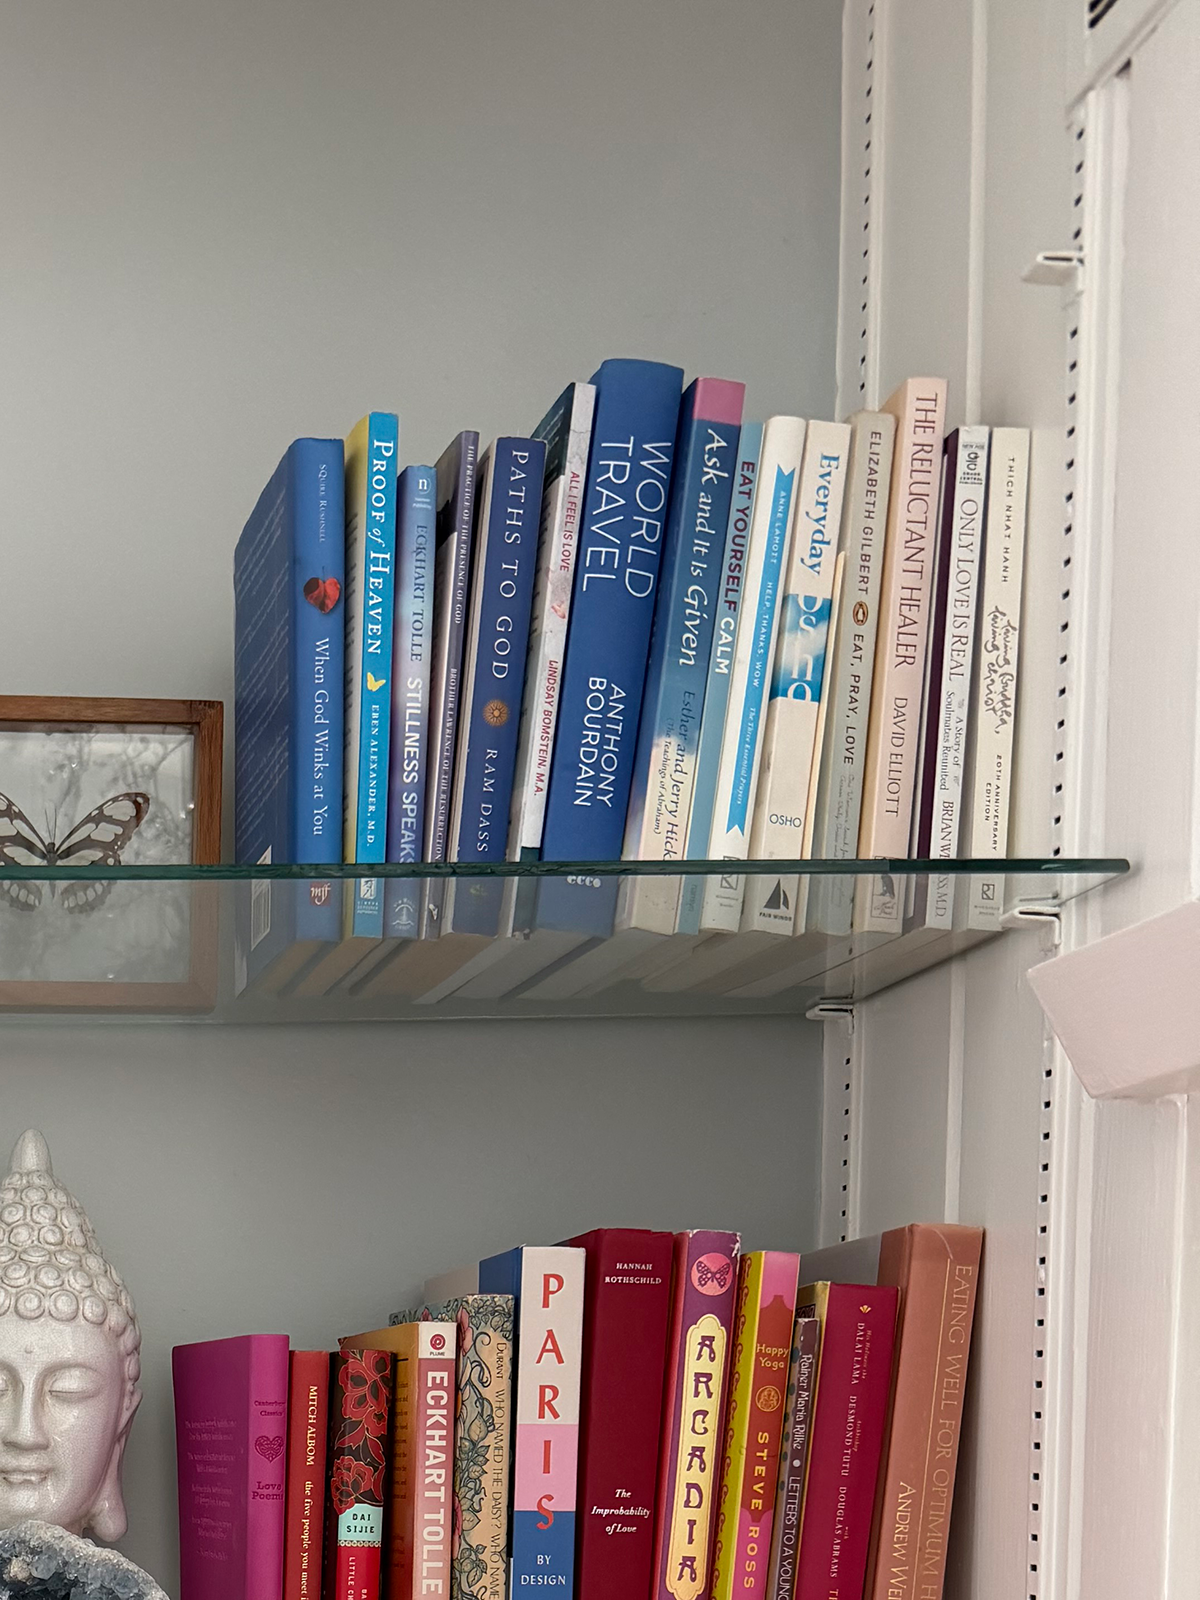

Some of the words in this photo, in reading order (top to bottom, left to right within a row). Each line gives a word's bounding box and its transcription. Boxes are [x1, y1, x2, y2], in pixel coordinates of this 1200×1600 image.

[914, 393, 938, 434] THE
[701, 428, 729, 485] Ask
[738, 461, 754, 500] EAT
[372, 440, 393, 522] PROOF
[504, 450, 529, 544] PATHS
[582, 437, 633, 593] TRAVEL
[625, 441, 671, 598] WORLD
[695, 491, 716, 535] and
[801, 453, 840, 575] Everyday
[902, 443, 933, 577] RELUCTANT
[958, 499, 978, 552] ONLY
[368, 529, 385, 547] of
[694, 539, 708, 557] It
[724, 507, 752, 611] YOURSELF
[500, 559, 518, 598] TO
[691, 560, 704, 578] Is
[954, 559, 974, 609] LOVE
[368, 551, 390, 654] HEAVEN
[679, 585, 708, 666] Given
[953, 614, 968, 630] IS
[492, 615, 513, 679] GOD
[714, 617, 735, 674] CALM
[851, 633, 864, 666] EAT,
[893, 586, 921, 668] HEALER
[314, 637, 329, 683] When
[949, 633, 968, 681] REAL
[314, 690, 328, 723] God
[846, 674, 860, 718] PRAY,
[314, 729, 329, 779] Winks
[573, 677, 607, 806] BOURDAIN
[596, 683, 626, 809] ANTHONY
[843, 726, 856, 764] LOVE
[314, 784, 324, 799] at
[313, 805, 328, 836] You
[769, 814, 801, 827] OSHO
[605, 1275, 662, 1285] ROTHSCHILD
[617, 1262, 652, 1271] HANNAH
[949, 1265, 972, 1344] EATING
[756, 1344, 789, 1358] Happy
[759, 1356, 784, 1370] Yoga
[535, 1273, 564, 1530] PARIS
[942, 1355, 963, 1410] WELL
[425, 1371, 448, 1503] ECKHART
[679, 1335, 717, 1584] ARCADIA
[936, 1420, 955, 1459] FOR
[616, 1489, 631, 1499] The
[752, 1432, 769, 1510] STEVE
[346, 1525, 375, 1534] SIJIE
[352, 1514, 370, 1522] DAI
[591, 1505, 651, 1519] Improbability
[606, 1524, 617, 1534] of
[618, 1524, 637, 1534] Love
[893, 1481, 916, 1561] ANDREW
[923, 1469, 950, 1576] OPTIMUM
[421, 1508, 444, 1595] TOLLE
[537, 1555, 551, 1566] BY
[744, 1526, 760, 1589] ROSS
[521, 1574, 565, 1585] DESIGN
